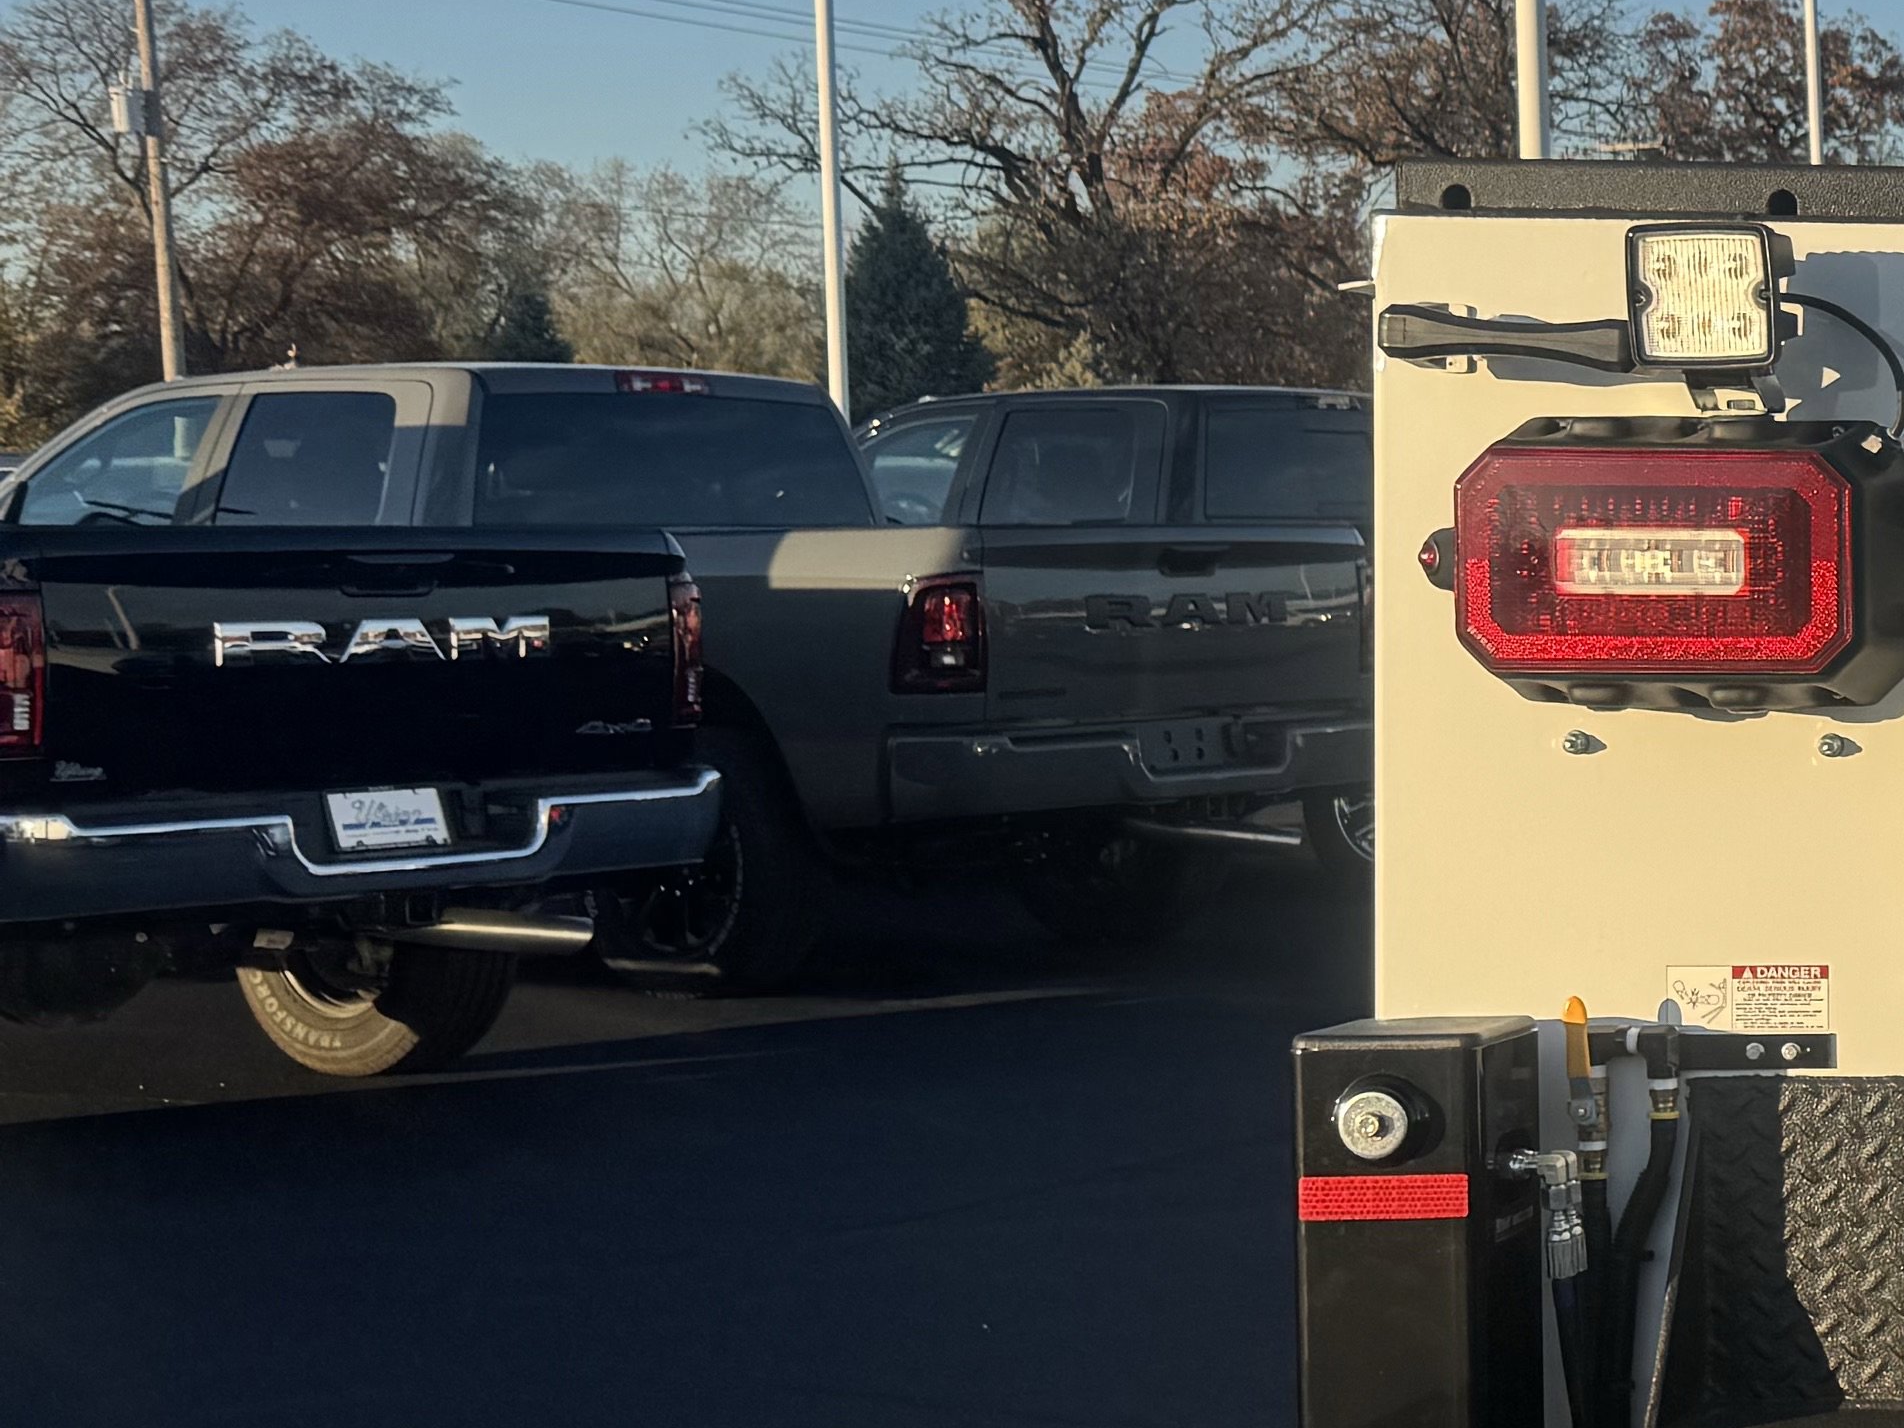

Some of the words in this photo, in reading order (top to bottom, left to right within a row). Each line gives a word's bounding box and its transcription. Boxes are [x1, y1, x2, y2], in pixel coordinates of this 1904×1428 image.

[1084, 590, 1288, 628] RAM
[213, 616, 549, 667] RAM
[1756, 967, 1821, 978] DANGER
[249, 970, 342, 1048] TRANSFORC
